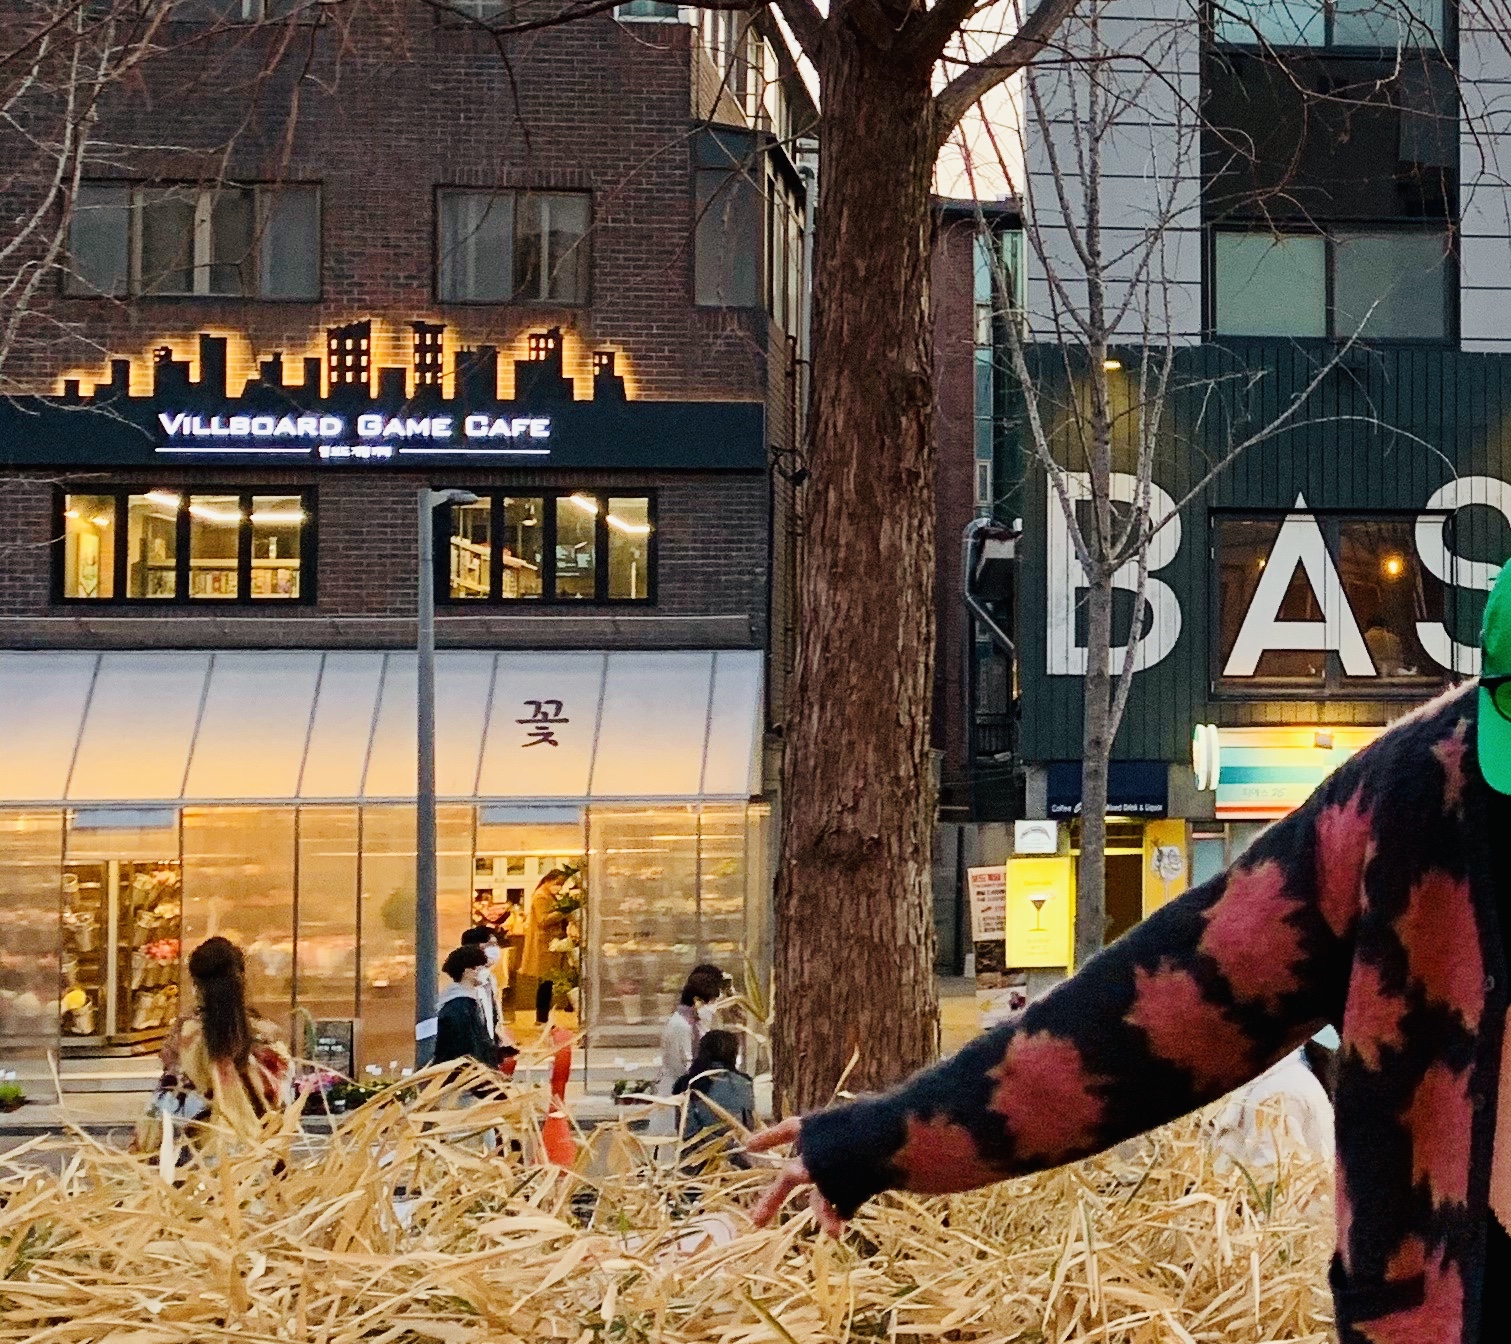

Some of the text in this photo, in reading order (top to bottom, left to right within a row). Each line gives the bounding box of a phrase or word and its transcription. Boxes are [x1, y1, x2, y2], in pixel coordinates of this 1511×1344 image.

[356, 414, 453, 437] GAME
[465, 415, 551, 438] CAFE
[515, 699, 570, 748] 꽃
